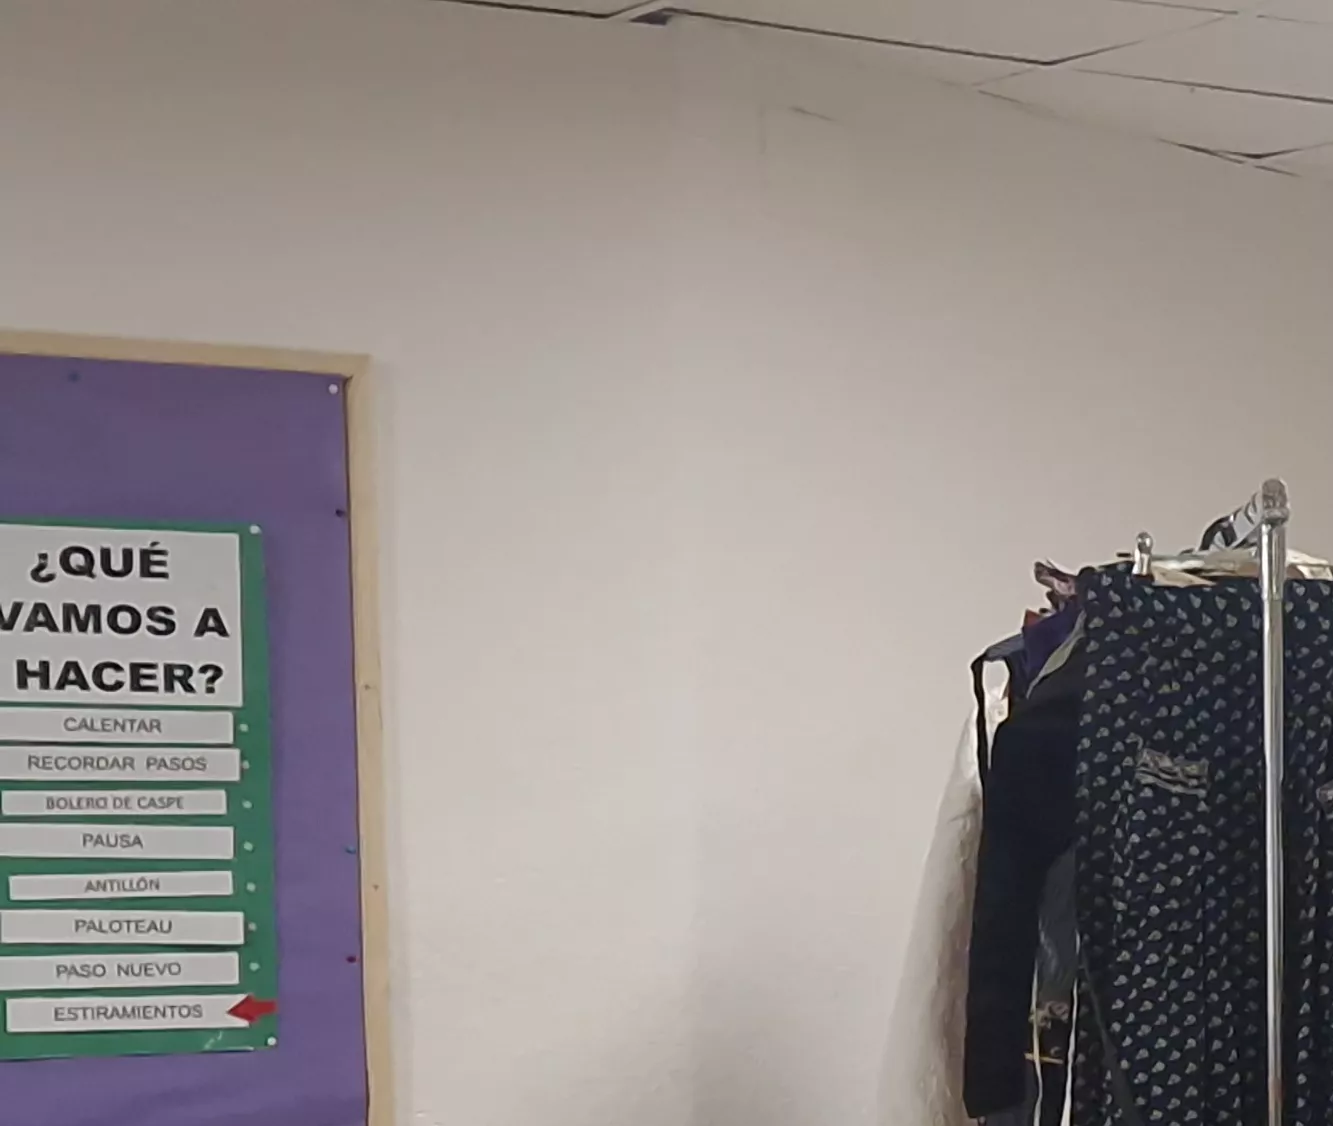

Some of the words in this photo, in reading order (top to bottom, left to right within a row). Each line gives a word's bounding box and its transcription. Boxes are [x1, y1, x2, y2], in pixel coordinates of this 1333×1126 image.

[30, 541, 170, 584] ¿QUÉ
[193, 607, 231, 639] A
[15, 659, 224, 695] HACER?
[63, 716, 163, 734] CALENTAR
[27, 754, 136, 771] RECORDAR
[146, 756, 208, 772] PASOS
[45, 795, 108, 811] BOLERO
[113, 796, 132, 810] DE
[137, 796, 185, 810] CASPE
[82, 833, 144, 849] PAUSA
[84, 877, 161, 893] ANTILLÓN
[74, 918, 173, 935] PALOTEAU
[55, 963, 107, 981] PASO
[117, 961, 182, 978] NUEVO
[53, 1003, 204, 1022] ESTIRAMIENTOS
